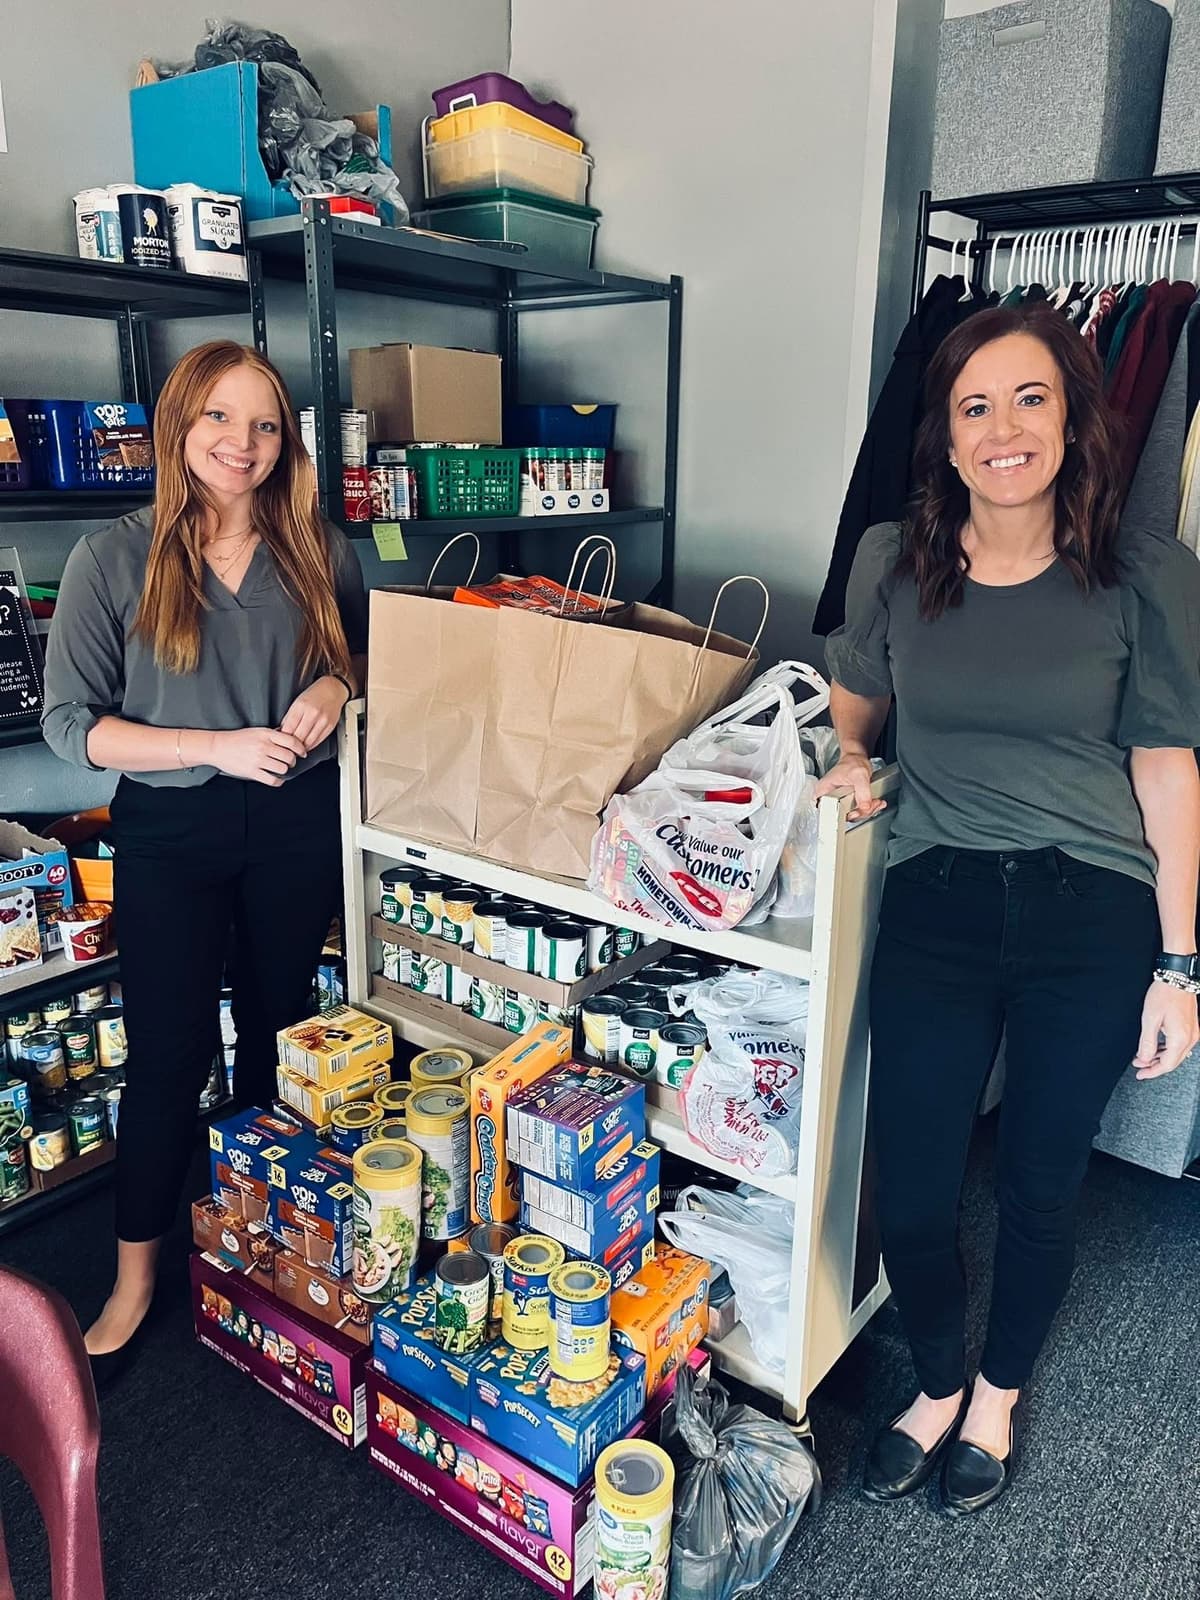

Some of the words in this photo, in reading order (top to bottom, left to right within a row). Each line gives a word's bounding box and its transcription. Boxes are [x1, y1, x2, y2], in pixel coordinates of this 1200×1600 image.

[202, 219, 239, 230] GRANULATED
[210, 227, 236, 237] SUGAR
[133, 236, 168, 249] MORTON
[15, 674, 30, 682] with
[0, 683, 28, 692] tudents
[688, 836, 718, 855] Value
[721, 846, 744, 860] our
[49, 867, 65, 877] 40
[637, 866, 690, 929] HOMETOWN
[616, 935, 634, 943] SWEET
[617, 943, 632, 951] CORN
[630, 1051, 651, 1060] SWEET
[631, 1060, 648, 1069] CORN
[18, 1089, 26, 1099] 8
[211, 1134, 219, 1147] 16
[580, 1132, 590, 1145] 16
[476, 1117, 497, 1178] Golden
[274, 1170, 282, 1183] 16
[506, 1255, 537, 1273] StarKist
[336, 1408, 348, 1426] 42
[499, 1516, 541, 1560] flavor
[550, 1551, 566, 1571] 42
